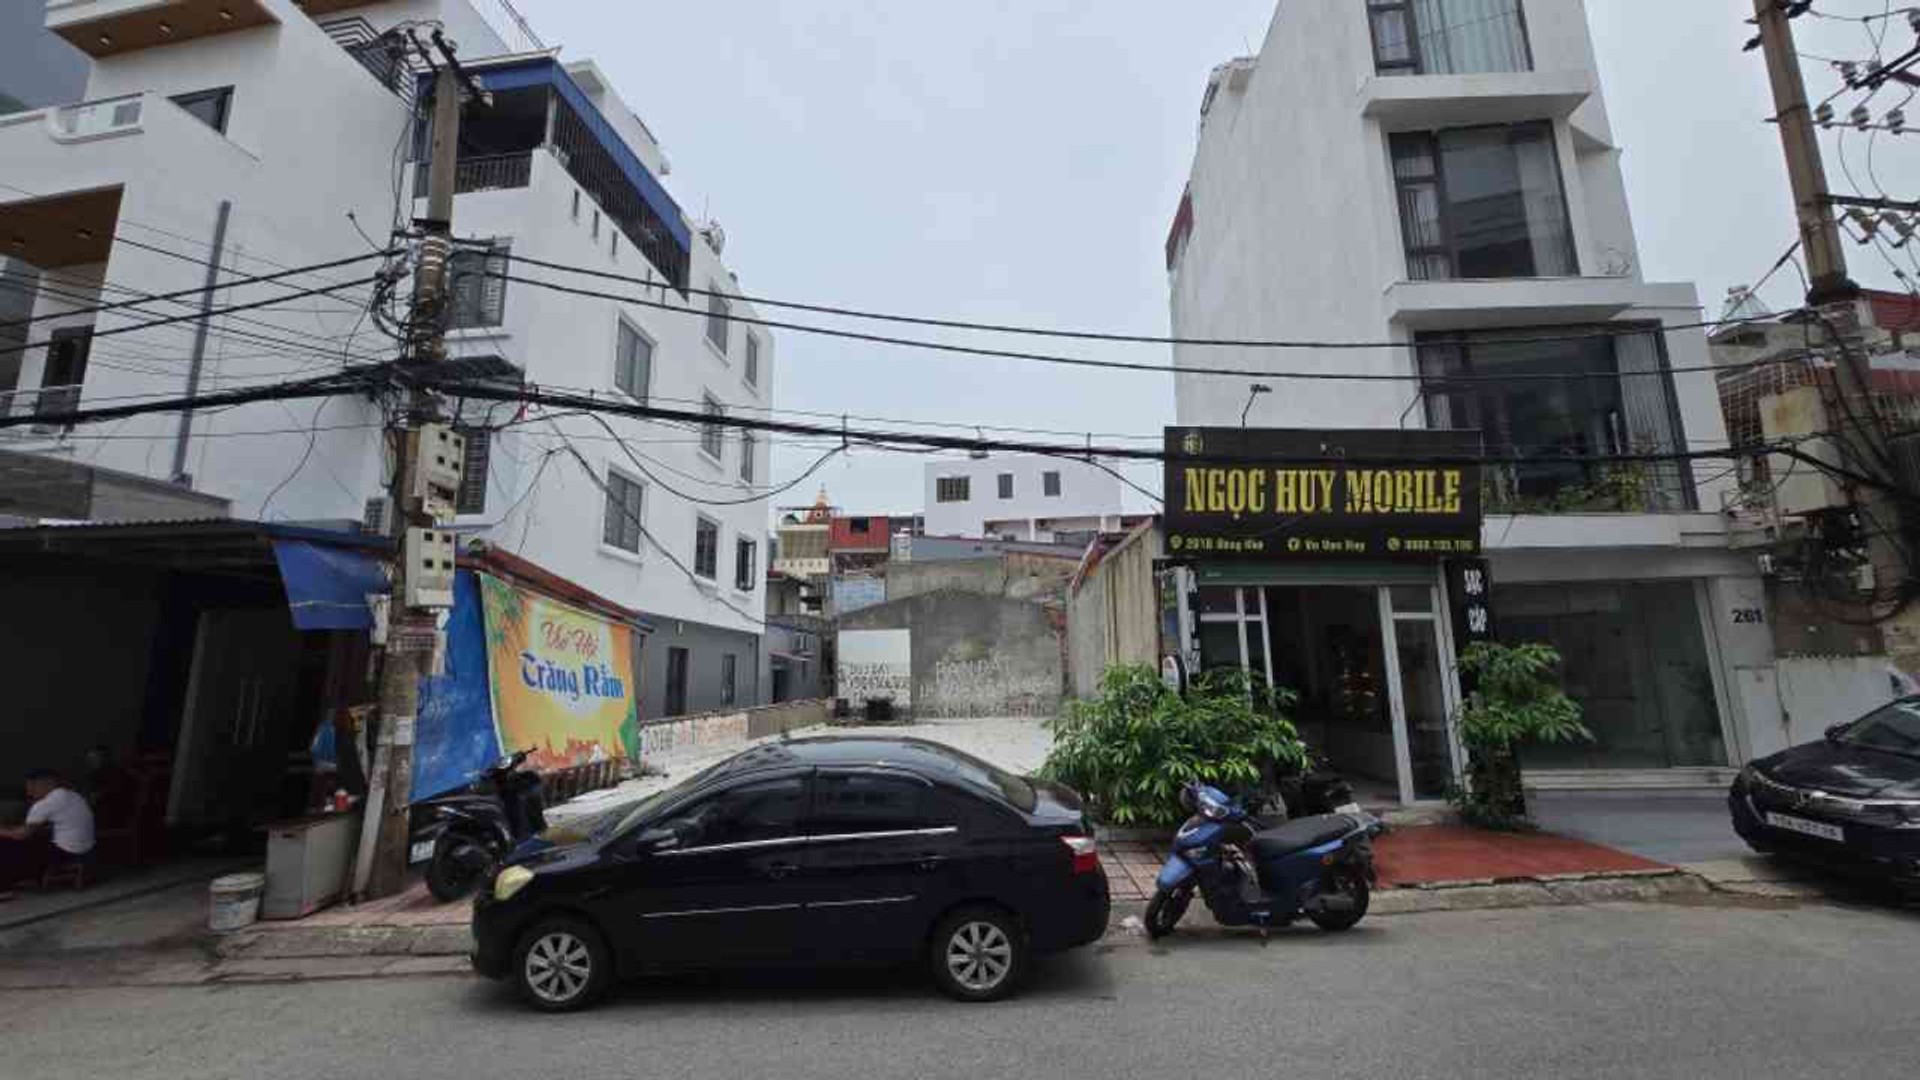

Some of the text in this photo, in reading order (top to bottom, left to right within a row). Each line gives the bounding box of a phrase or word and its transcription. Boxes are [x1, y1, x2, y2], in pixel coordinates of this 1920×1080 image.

[1184, 467, 1462, 520] NGỌC HUY MOBILE
[520, 650, 581, 702] Trăng
